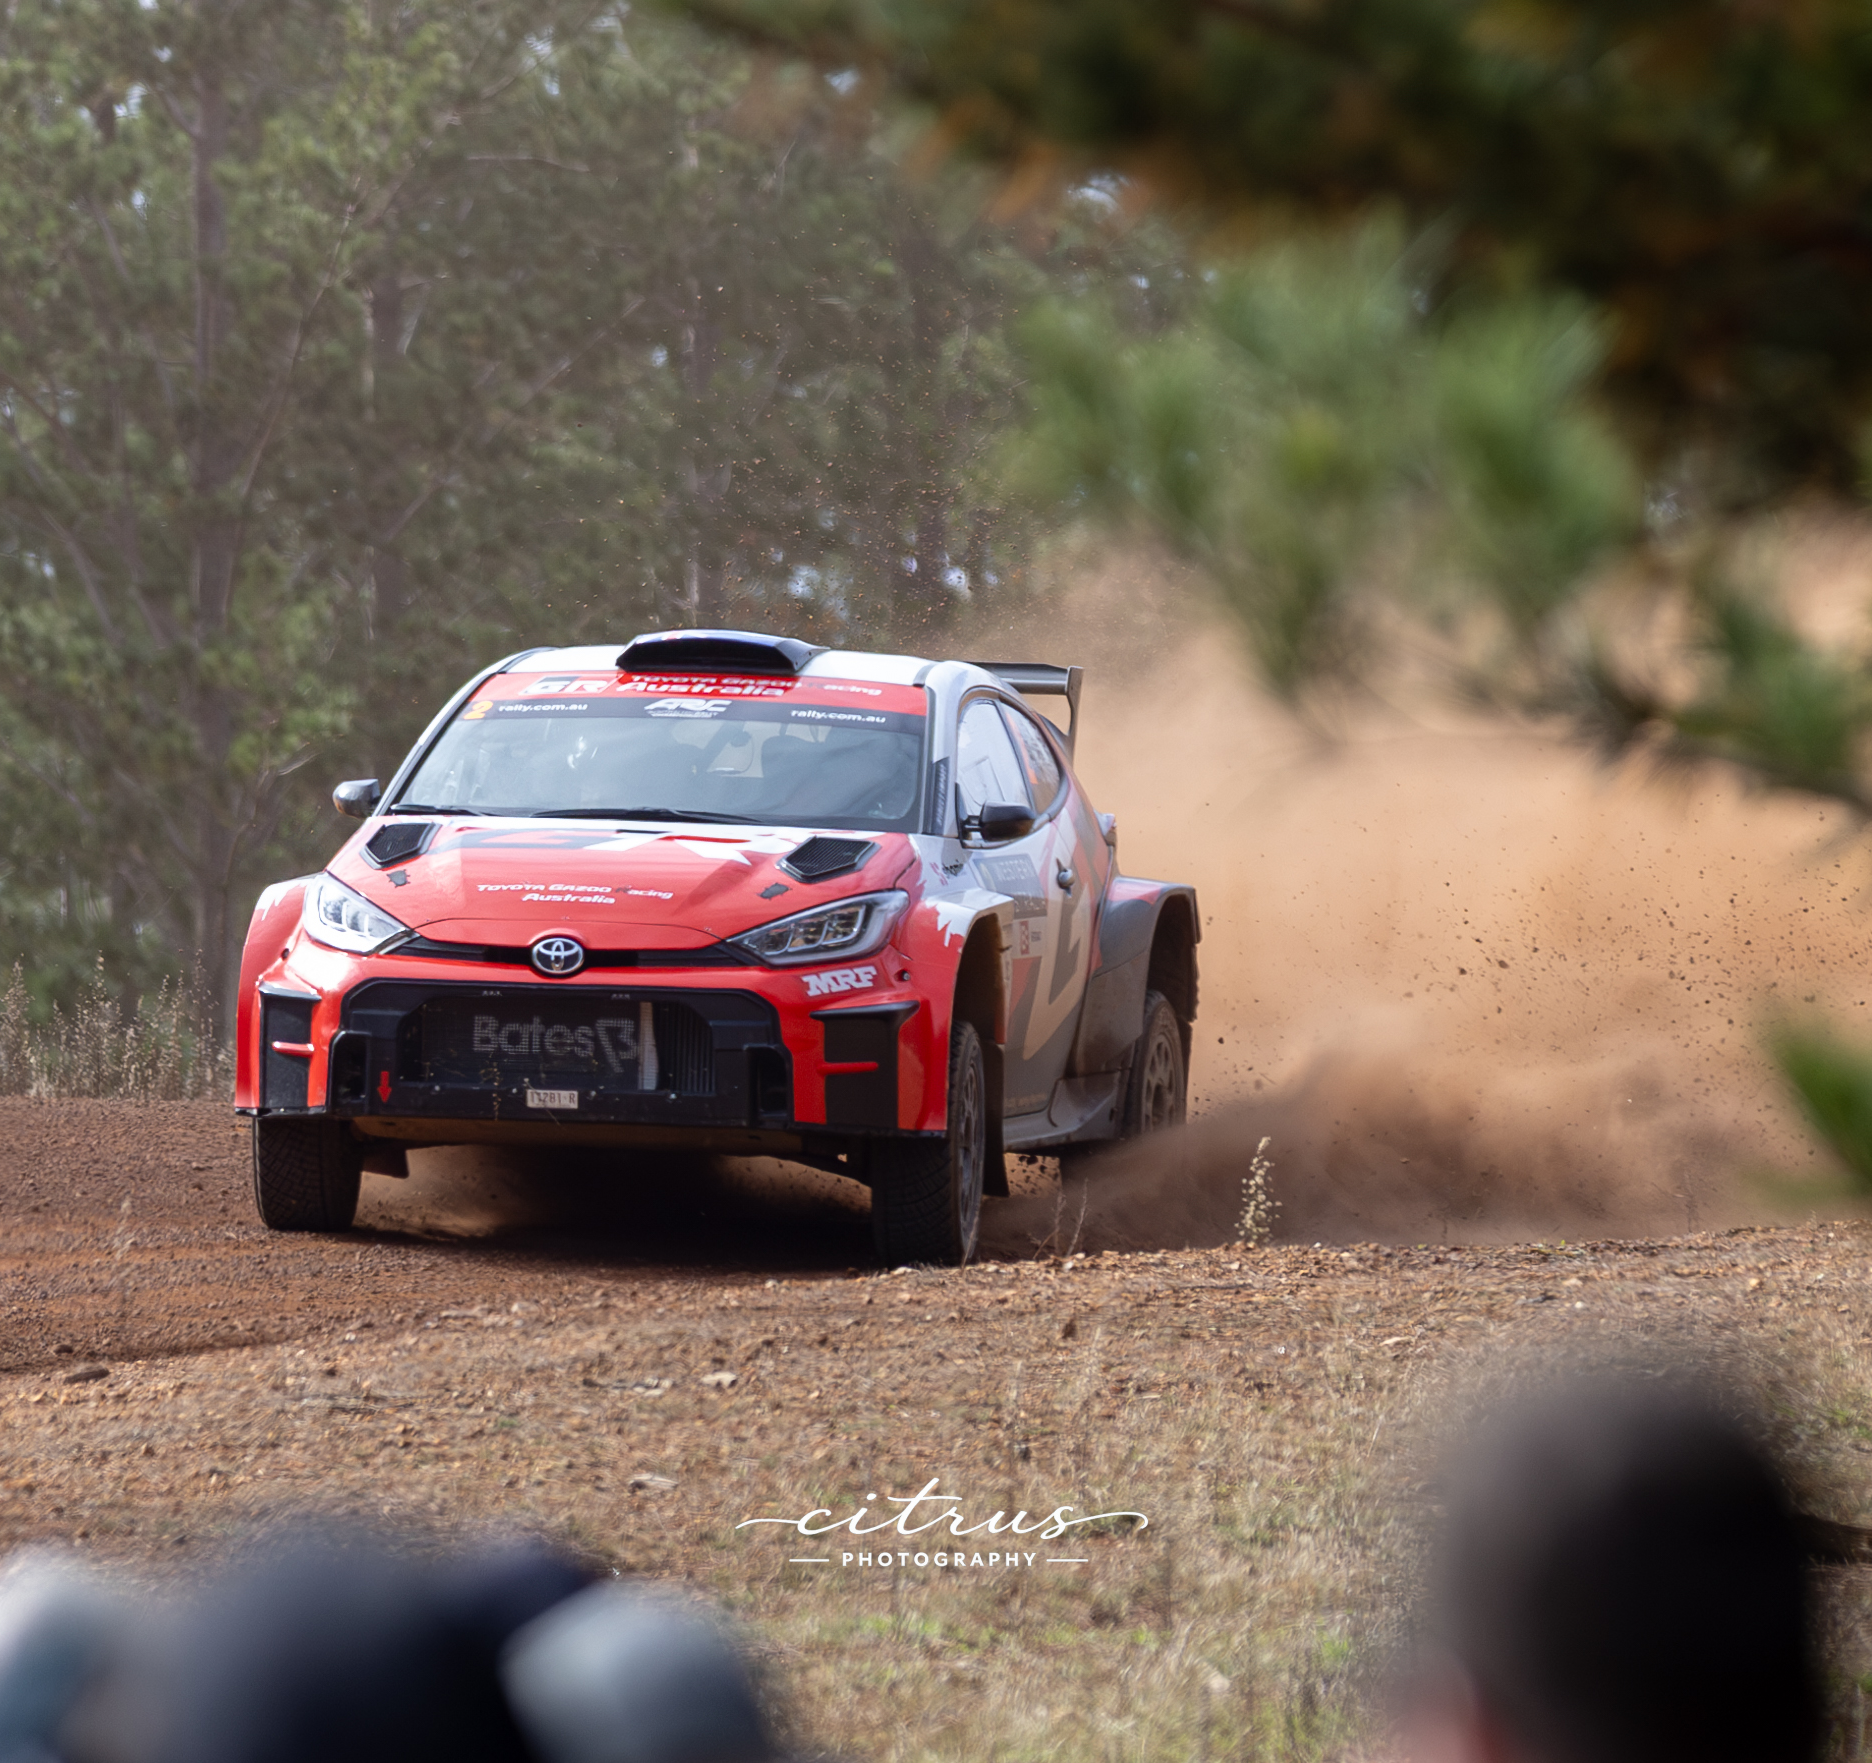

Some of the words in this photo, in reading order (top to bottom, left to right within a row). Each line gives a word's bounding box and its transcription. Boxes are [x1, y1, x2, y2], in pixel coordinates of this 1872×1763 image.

[616, 681, 785, 696] Australia
[463, 700, 494, 720] 2
[497, 702, 588, 713] rally.com.au
[643, 697, 733, 713] ARC
[790, 708, 886, 723] rally.com.au
[477, 883, 545, 892] TOYOTA
[521, 893, 616, 904] Australia
[801, 965, 878, 997] MRF
[472, 1015, 596, 1058] Bates
